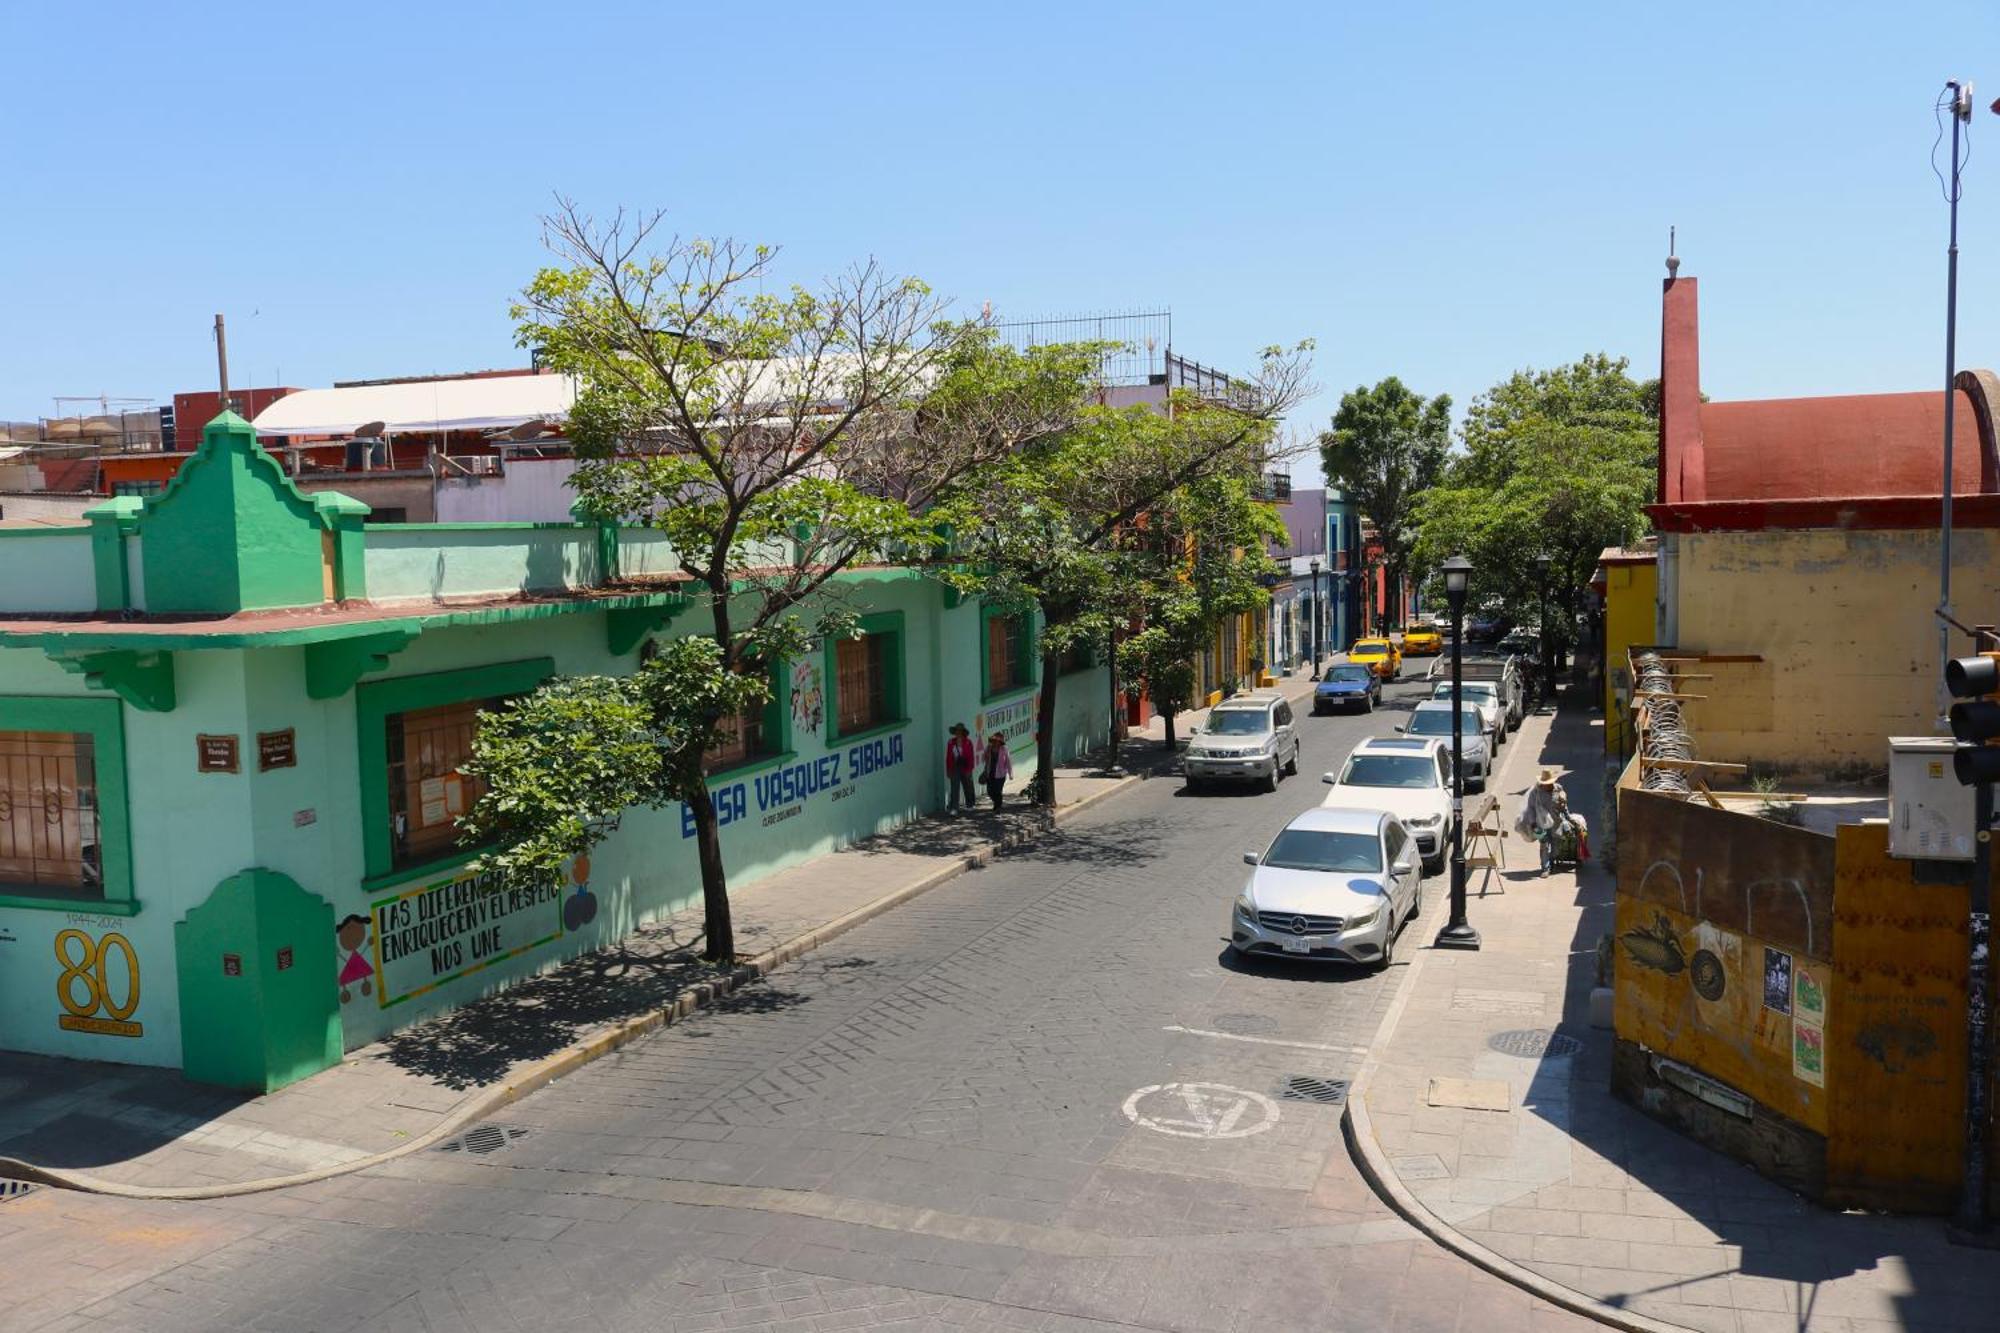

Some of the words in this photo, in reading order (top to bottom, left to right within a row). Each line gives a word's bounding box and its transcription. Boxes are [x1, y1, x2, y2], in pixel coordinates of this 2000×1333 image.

[681, 783, 747, 839] EISA
[848, 734, 904, 780] SIBAJA
[379, 899, 411, 934] LAS
[418, 866, 508, 921] DIFERENCIA
[381, 902, 478, 964] ENRIQUECEN
[477, 900, 488, 924] Y
[491, 894, 508, 919] EL
[55, 929, 140, 1021] 80
[431, 940, 462, 976] NOS
[471, 926, 503, 959] UNE
